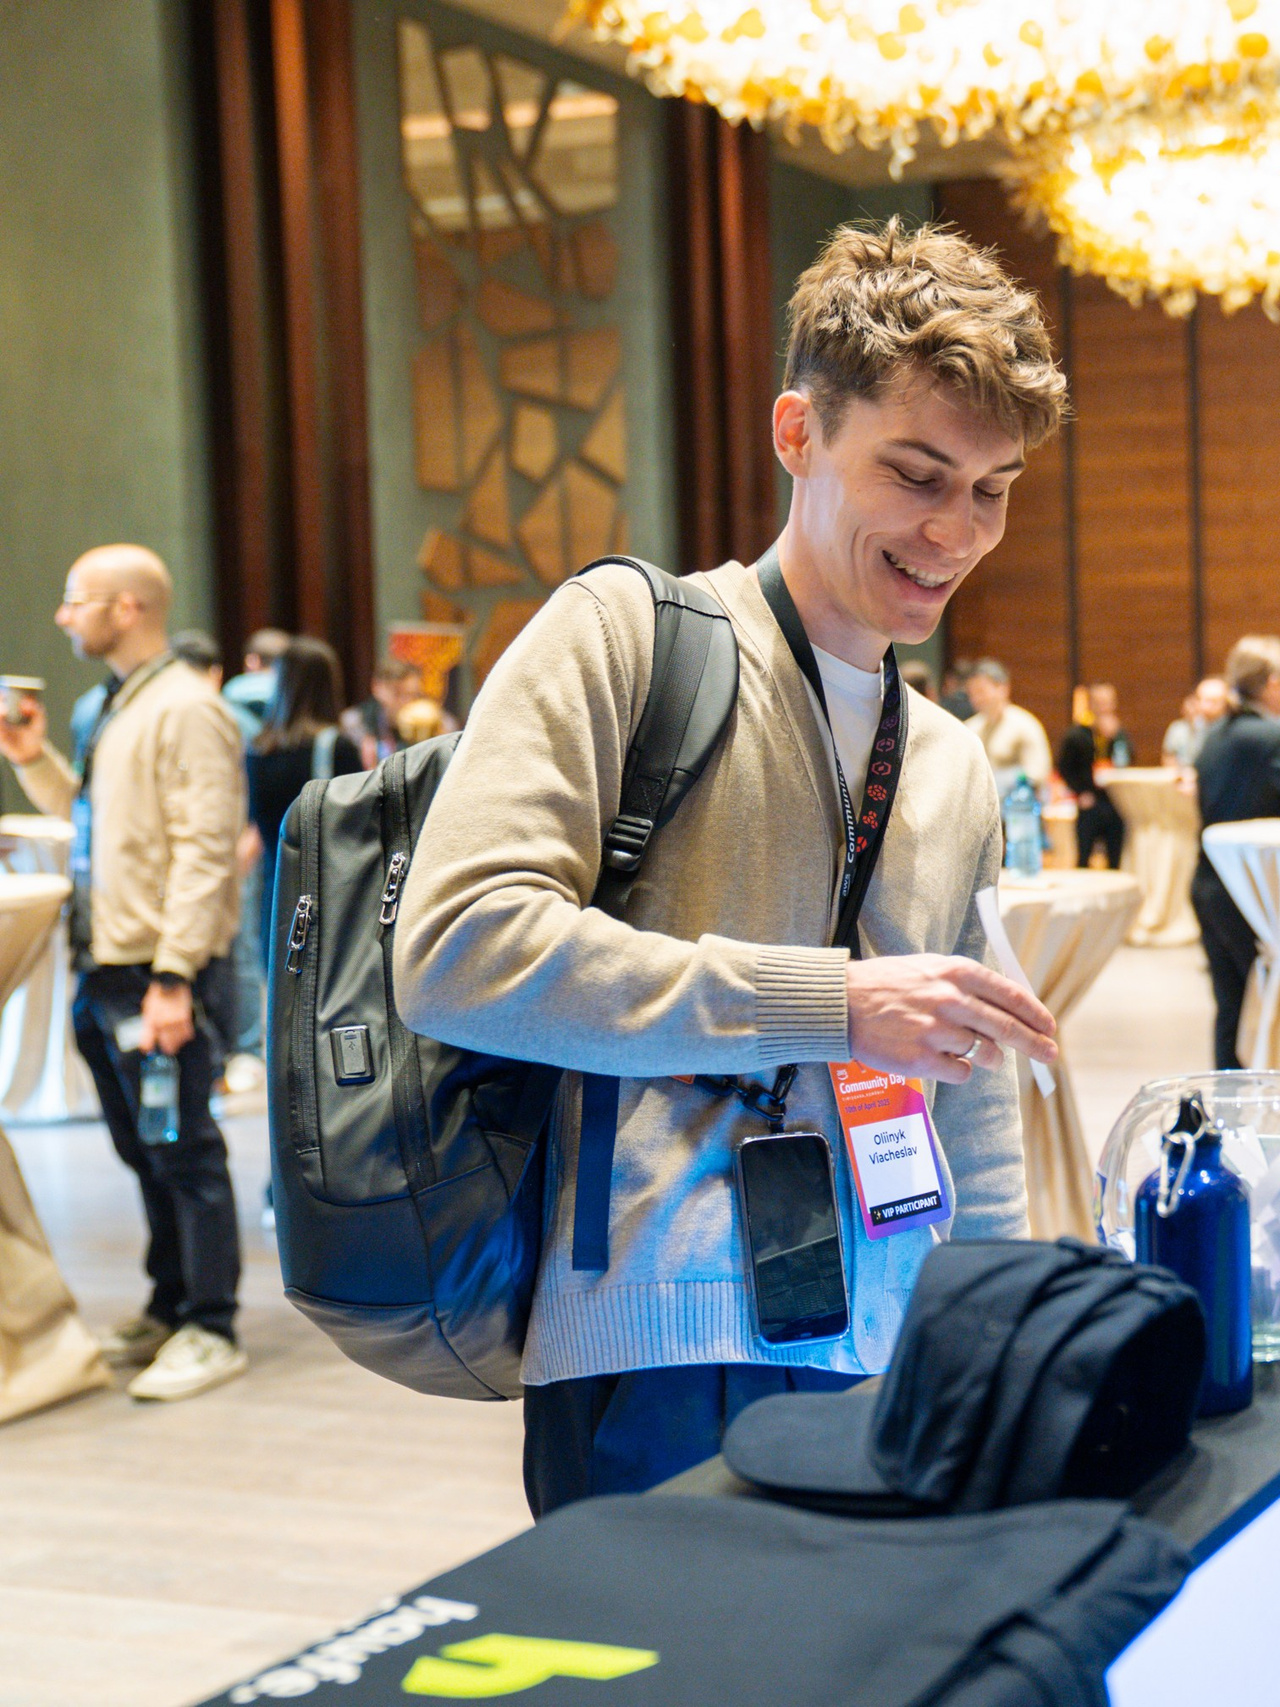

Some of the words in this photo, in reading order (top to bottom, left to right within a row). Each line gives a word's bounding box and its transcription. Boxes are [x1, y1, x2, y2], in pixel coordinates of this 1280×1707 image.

[839, 1076, 888, 1094] Community
[890, 1073, 906, 1086] Day
[873, 1129, 906, 1146] Oliinyk
[868, 1146, 918, 1164] Viacheslav
[882, 1207, 895, 1218] VIP
[895, 1195, 937, 1216] PARTICIPANT
